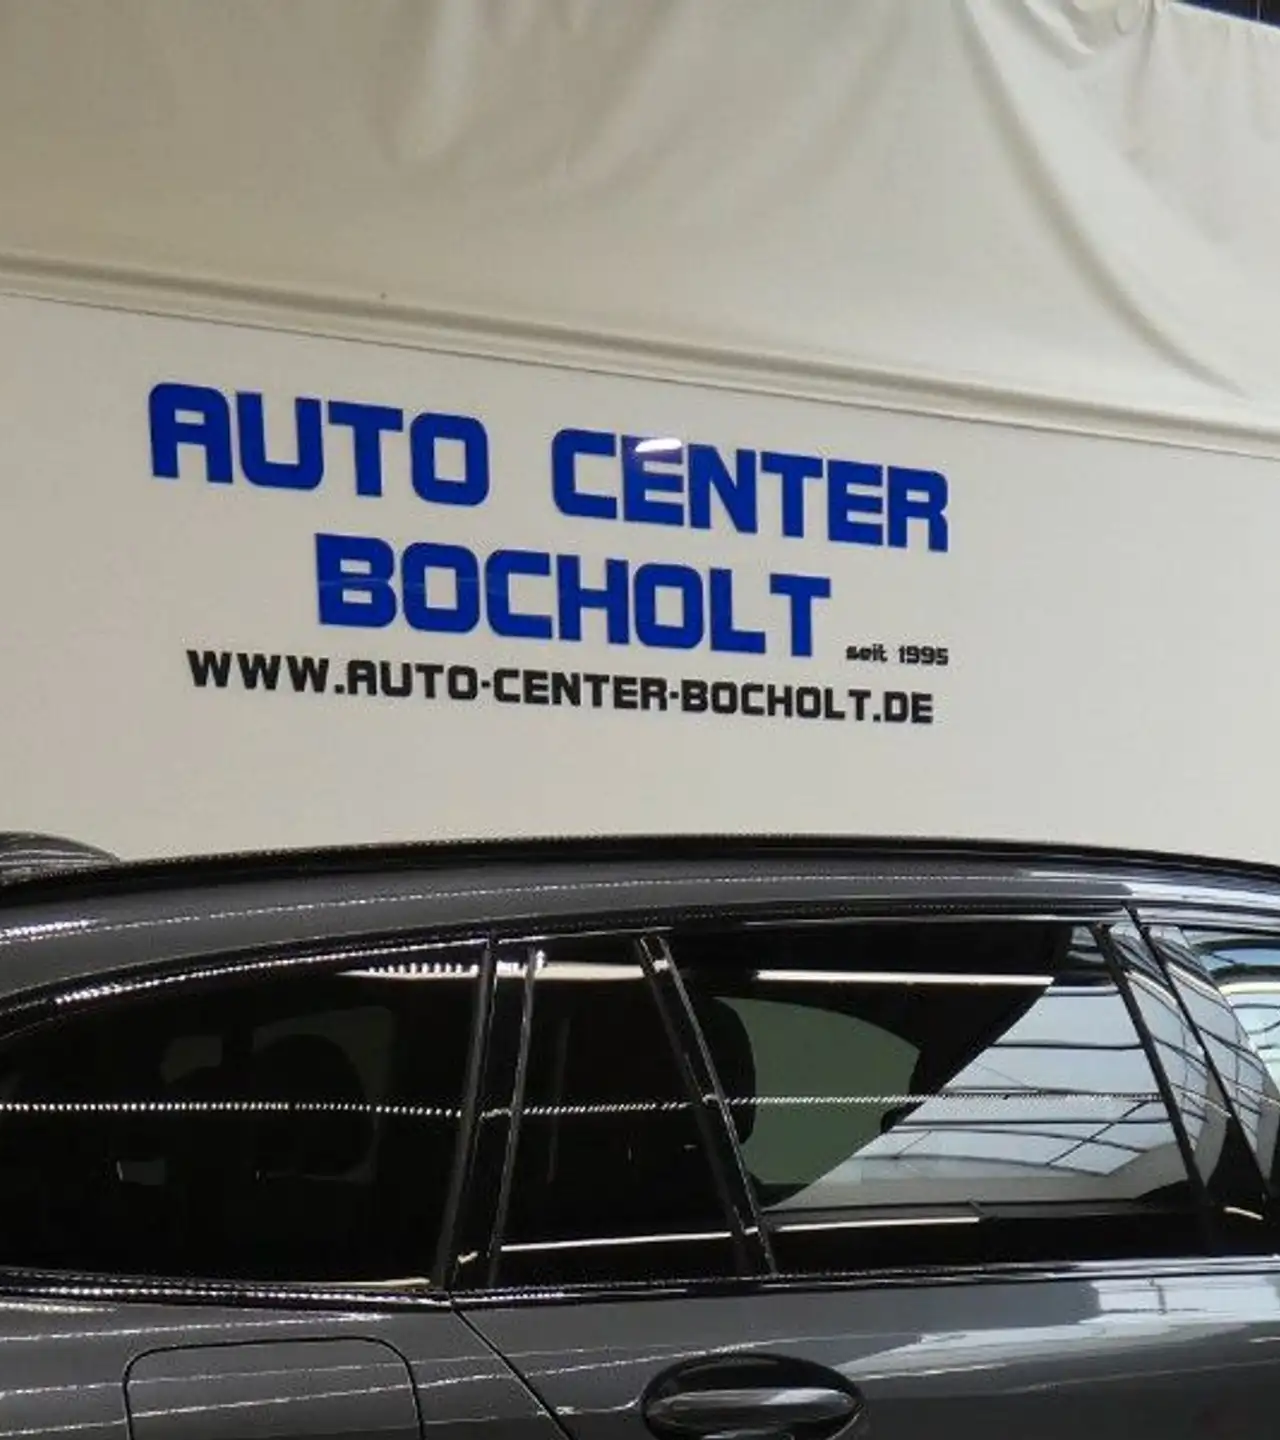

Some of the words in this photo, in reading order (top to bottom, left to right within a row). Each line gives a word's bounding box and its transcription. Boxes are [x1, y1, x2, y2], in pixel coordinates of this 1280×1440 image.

[148, 382, 490, 507] AUTO
[551, 428, 949, 553] CENTER
[314, 532, 831, 658] BOCHOLT
[186, 649, 933, 724] WWW.AUTO-CENTER-BOCHOLT.DE
[846, 643, 888, 663] seit
[898, 645, 949, 666] 1995
